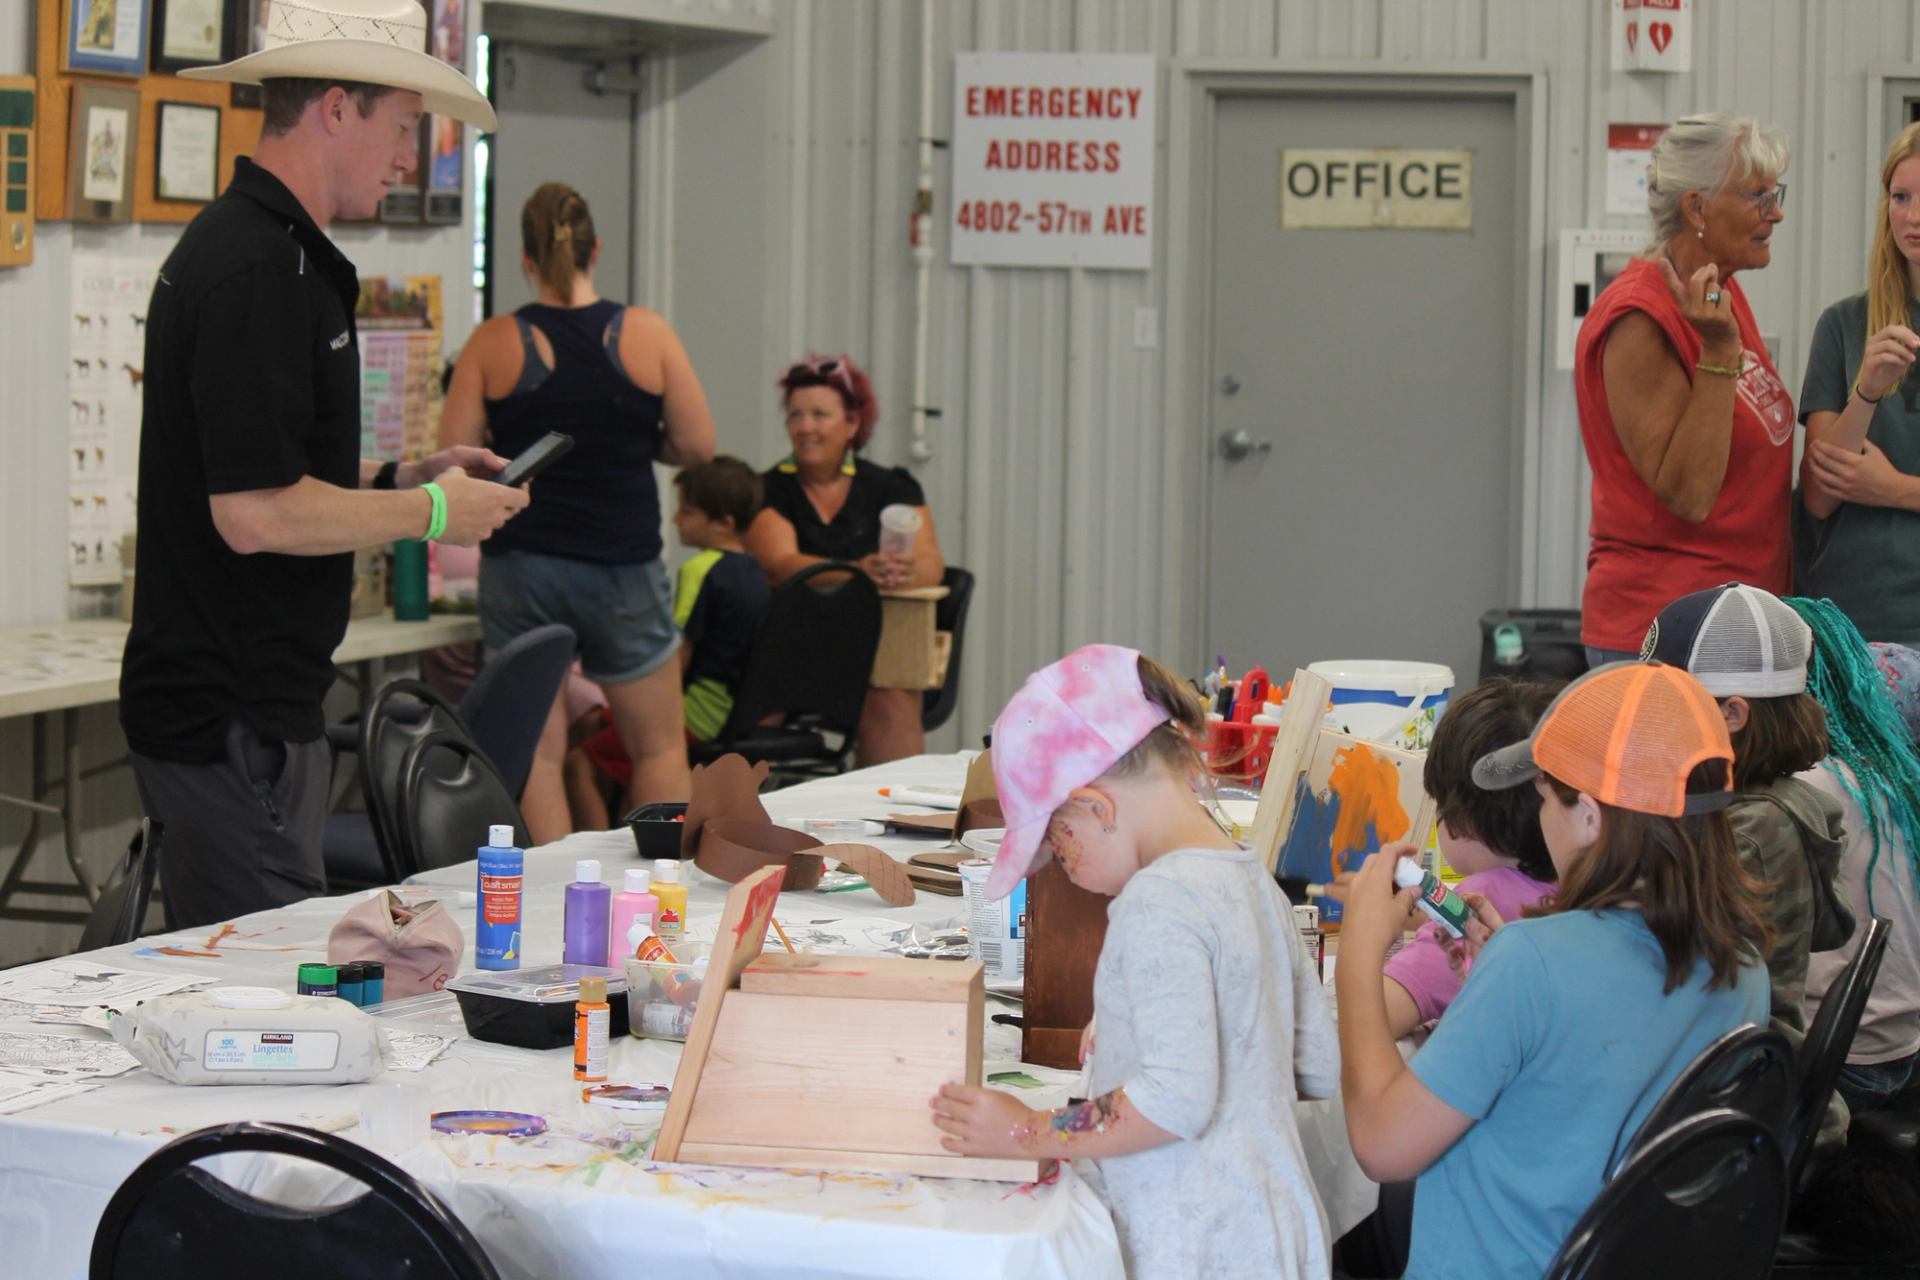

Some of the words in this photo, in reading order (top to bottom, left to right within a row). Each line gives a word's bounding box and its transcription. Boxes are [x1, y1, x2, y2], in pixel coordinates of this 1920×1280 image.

[966, 86, 1142, 119] EMERGENCY
[985, 138, 1121, 173] ADDRESS
[1288, 162, 1462, 198] OFFICE
[1104, 204, 1146, 235] AVE
[253, 1044, 294, 1055] Lingettes
